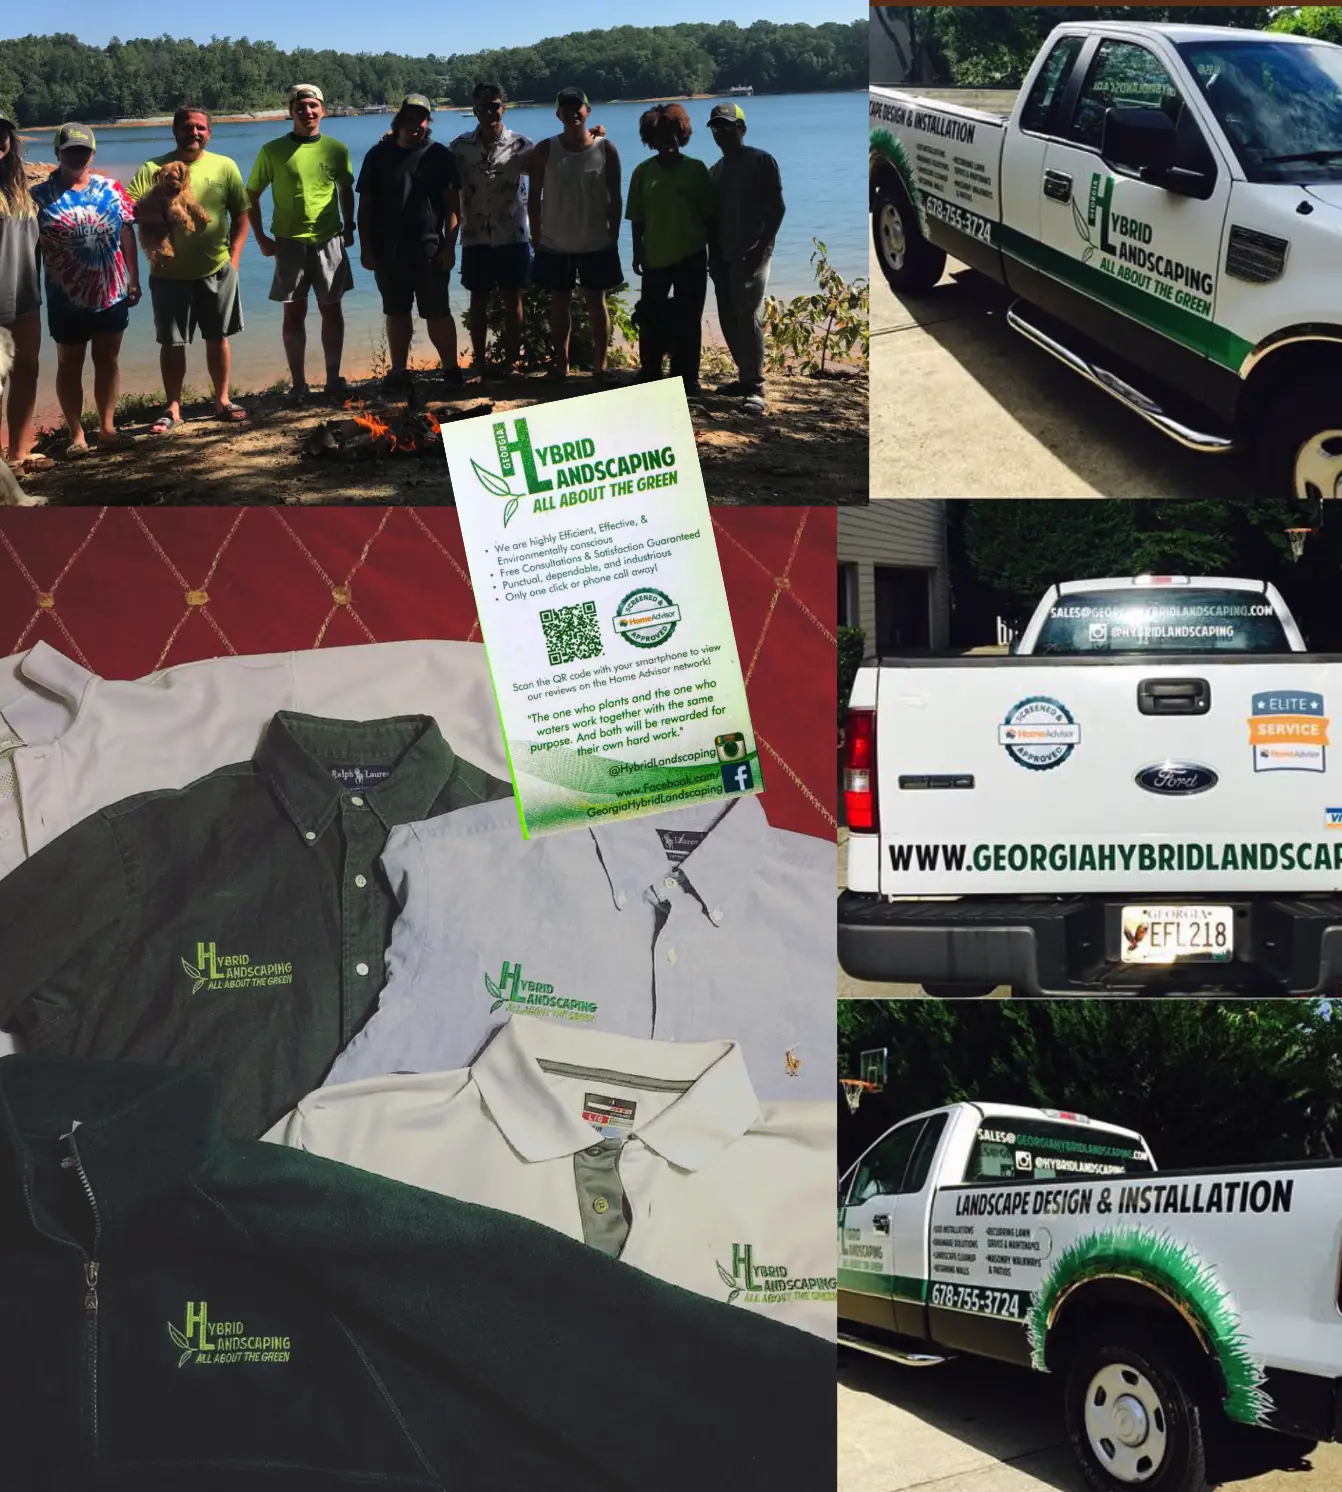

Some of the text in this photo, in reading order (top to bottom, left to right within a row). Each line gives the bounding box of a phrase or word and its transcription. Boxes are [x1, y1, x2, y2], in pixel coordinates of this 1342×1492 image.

[883, 103, 976, 144] DESIGN & INSTALLATION
[1089, 179, 1099, 220] GEORGIA
[926, 196, 992, 243] 678-755-3724
[1099, 257, 1212, 317] ALL ABOUT THE GREEN
[498, 428, 511, 469] GEORGIA
[533, 470, 678, 513] ALL ABOUT THE GREEN
[493, 514, 648, 552] We are highly Efficient, Effective, &
[497, 536, 613, 565] Environmentally conscious
[499, 528, 700, 577] Free Consultations & Satisfaction Guaranteed
[502, 549, 672, 589] Punctual, dependable, and industrious
[504, 562, 658, 601] Only one click or phone call away!
[626, 594, 658, 612] SCREENED
[629, 611, 675, 626] HomeAdvisor
[631, 625, 668, 641] APPROVED
[1111, 625, 1234, 638] @HYBRIDLANDSCAPING
[512, 644, 721, 691] Scan the QR code with your smartphone to view
[527, 692, 542, 701] our
[544, 685, 576, 697] reviews
[592, 678, 607, 687] the
[608, 673, 636, 684] Home
[638, 666, 670, 679] Advisor
[673, 656, 711, 671] network!
[527, 679, 716, 723] "The one who plants and the one who
[536, 695, 713, 736] waters work together with the same
[1016, 704, 1057, 722] SCREENED
[1268, 698, 1308, 711] ELITE
[530, 705, 725, 754] purpose. And both will be rewarded for
[576, 726, 683, 756] their own hard work."
[1017, 729, 1074, 739] HomeAdvisor
[1257, 723, 1320, 736] SERVICE
[608, 748, 716, 777] @HybridLandscaping
[1017, 746, 1063, 763] APPROVED
[331, 768, 354, 780] Ralph
[615, 770, 721, 798] www.Facebook.com/
[1153, 767, 1198, 790] Ford
[587, 785, 723, 818] GeorgiaHybridLandscaping
[1150, 922, 1227, 948] EFL218
[207, 974, 293, 990] ALL ABOUT THE GREEN
[955, 1179, 1294, 1216] LANDSCAPE DESIGN & INSTALLATION
[932, 1283, 1019, 1318] 678-755-3724
[195, 1351, 291, 1364] ALL ABOUT THE GREEN
